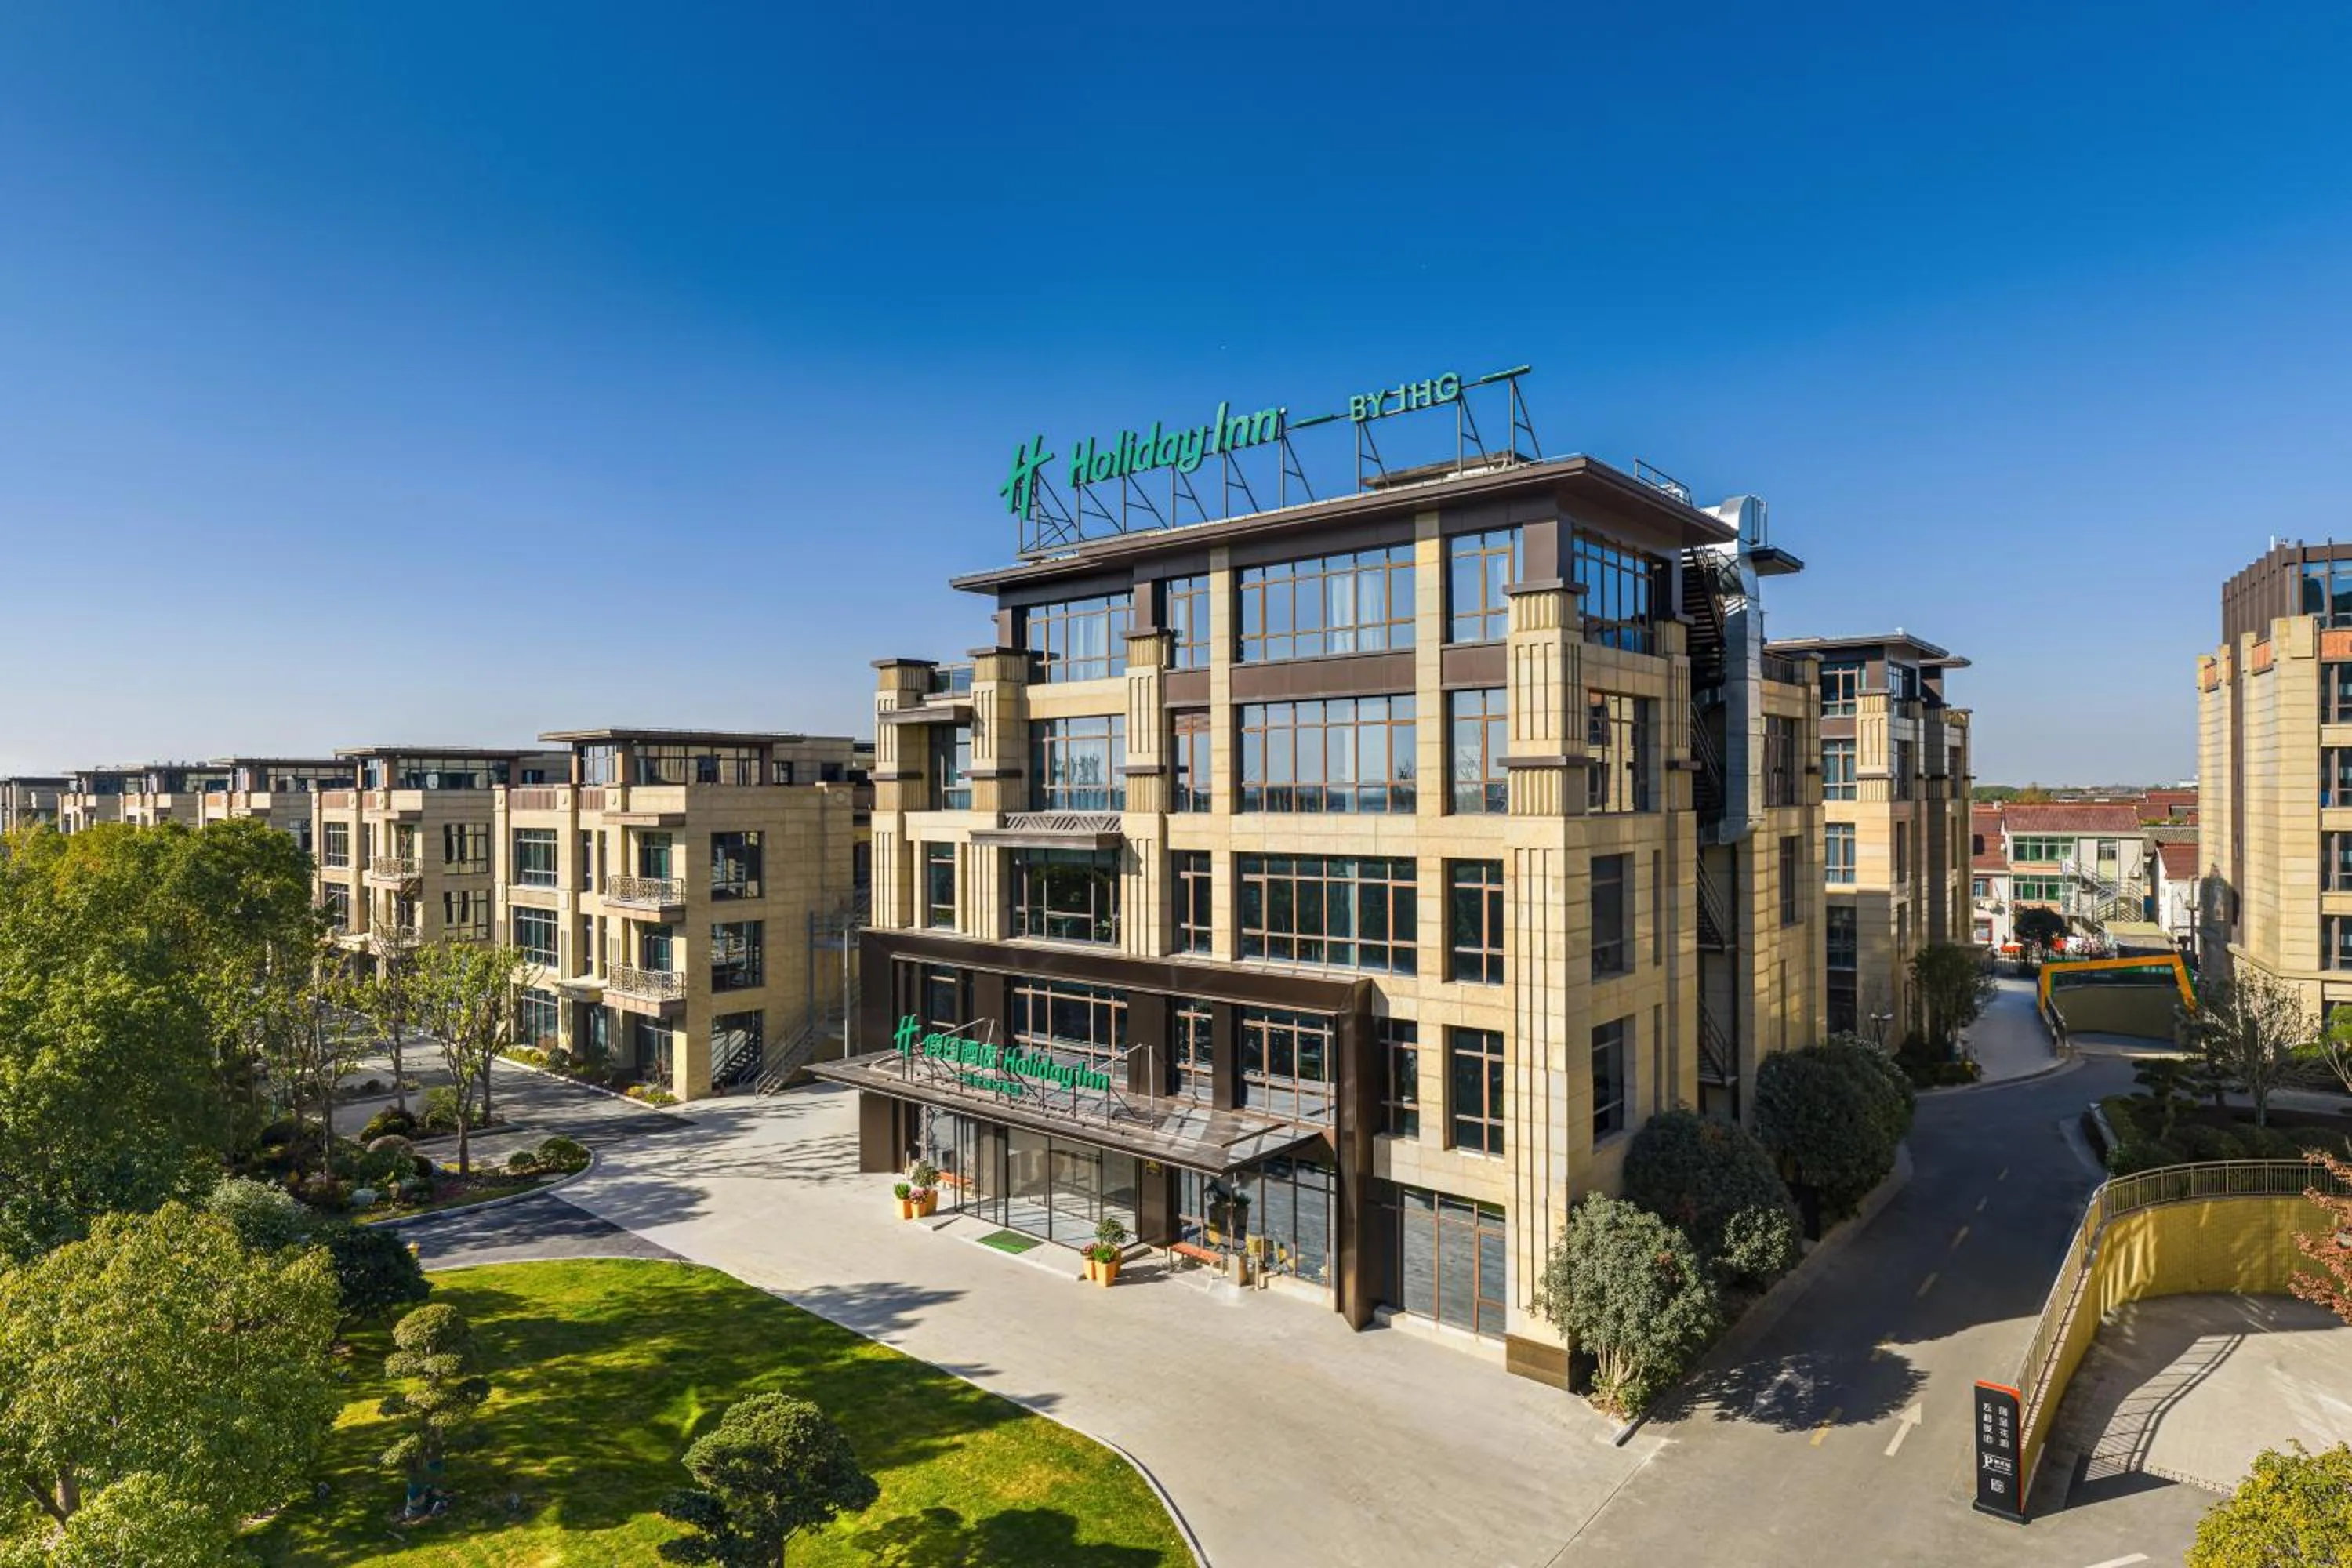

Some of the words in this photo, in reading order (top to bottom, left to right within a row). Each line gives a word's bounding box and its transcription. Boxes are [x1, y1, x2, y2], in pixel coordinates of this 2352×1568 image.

[1349, 390, 1388, 423] BY
[1398, 371, 1462, 412] IHG
[1069, 421, 1208, 489] Holiday
[1212, 401, 1279, 453] Inn
[923, 1033, 998, 1070] 假日酒店
[1002, 1047, 1076, 1092] Holiday
[1076, 1060, 1110, 1092] Inn
